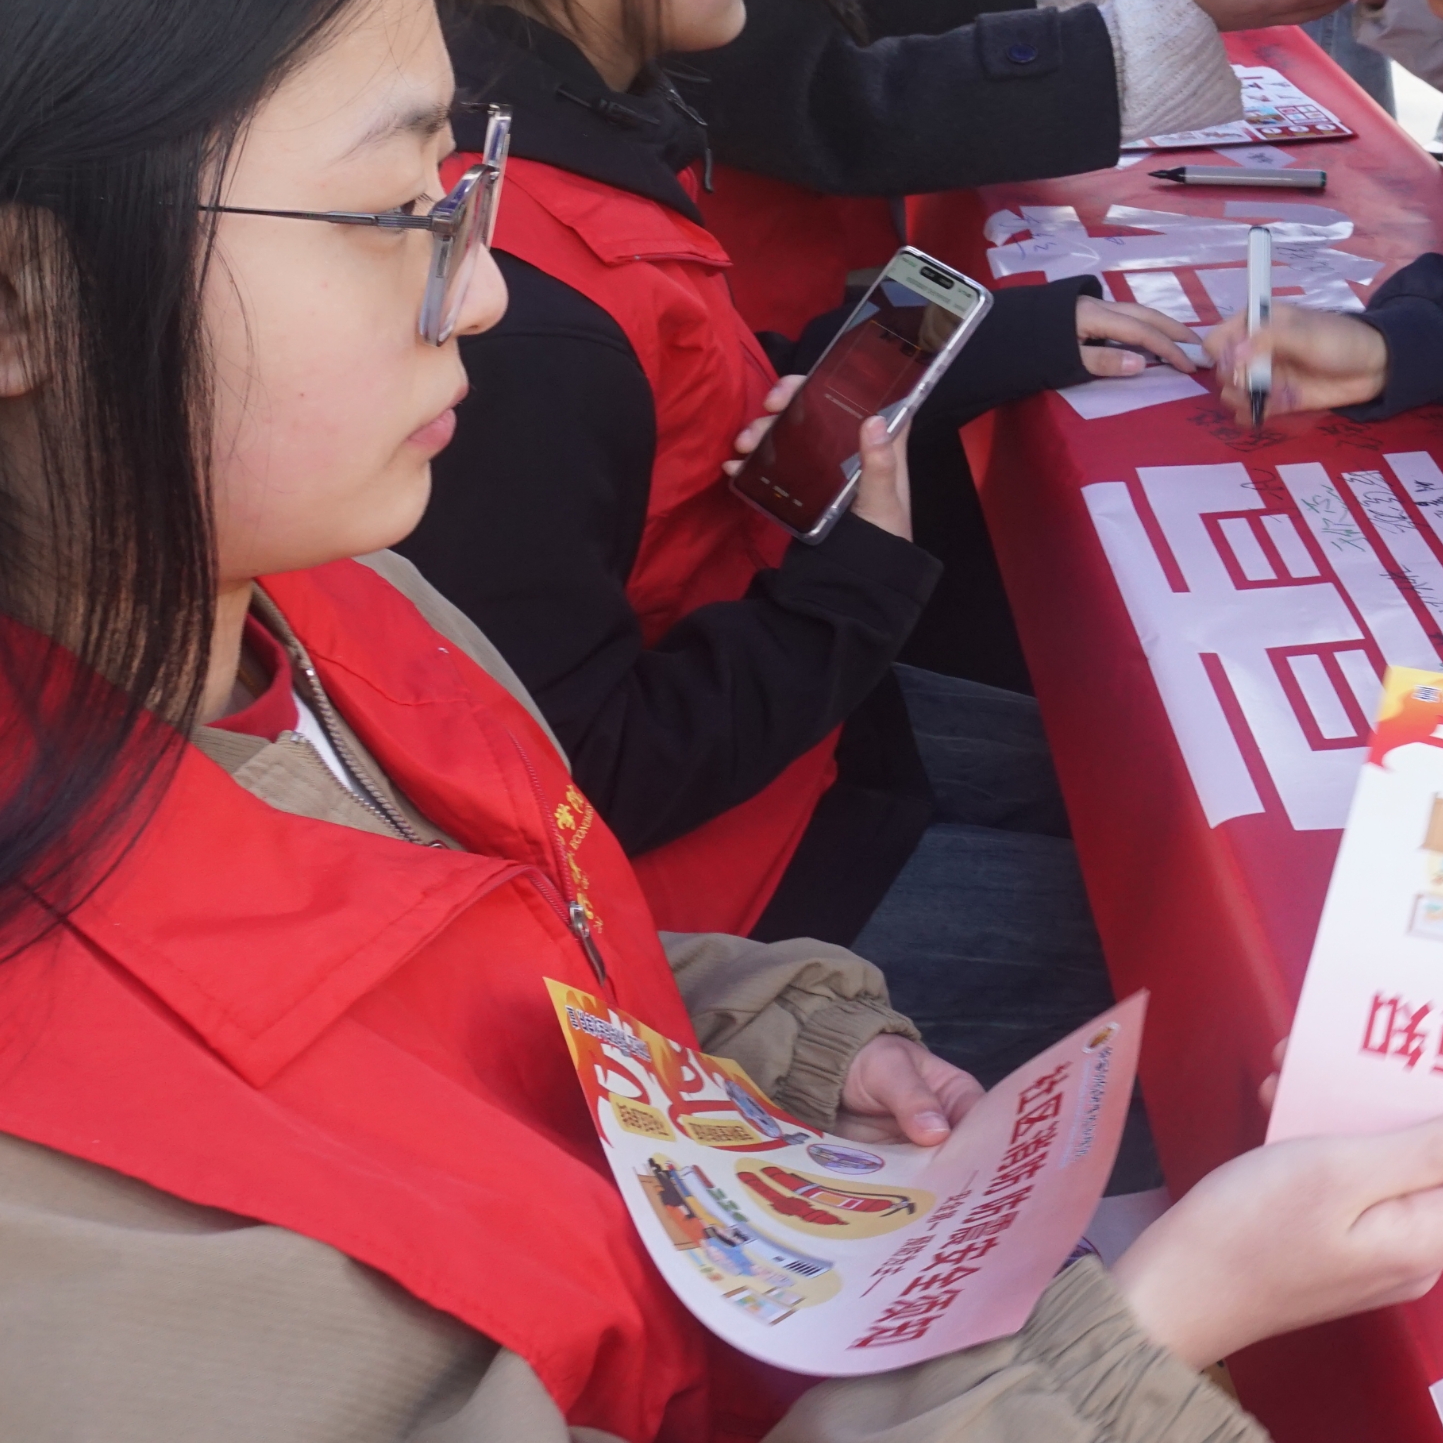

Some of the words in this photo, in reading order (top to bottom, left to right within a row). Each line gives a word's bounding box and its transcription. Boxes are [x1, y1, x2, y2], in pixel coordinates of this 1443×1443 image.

[981, 1064, 1073, 1194] 社区消防
[845, 1183, 1020, 1349] 防震安全须知
